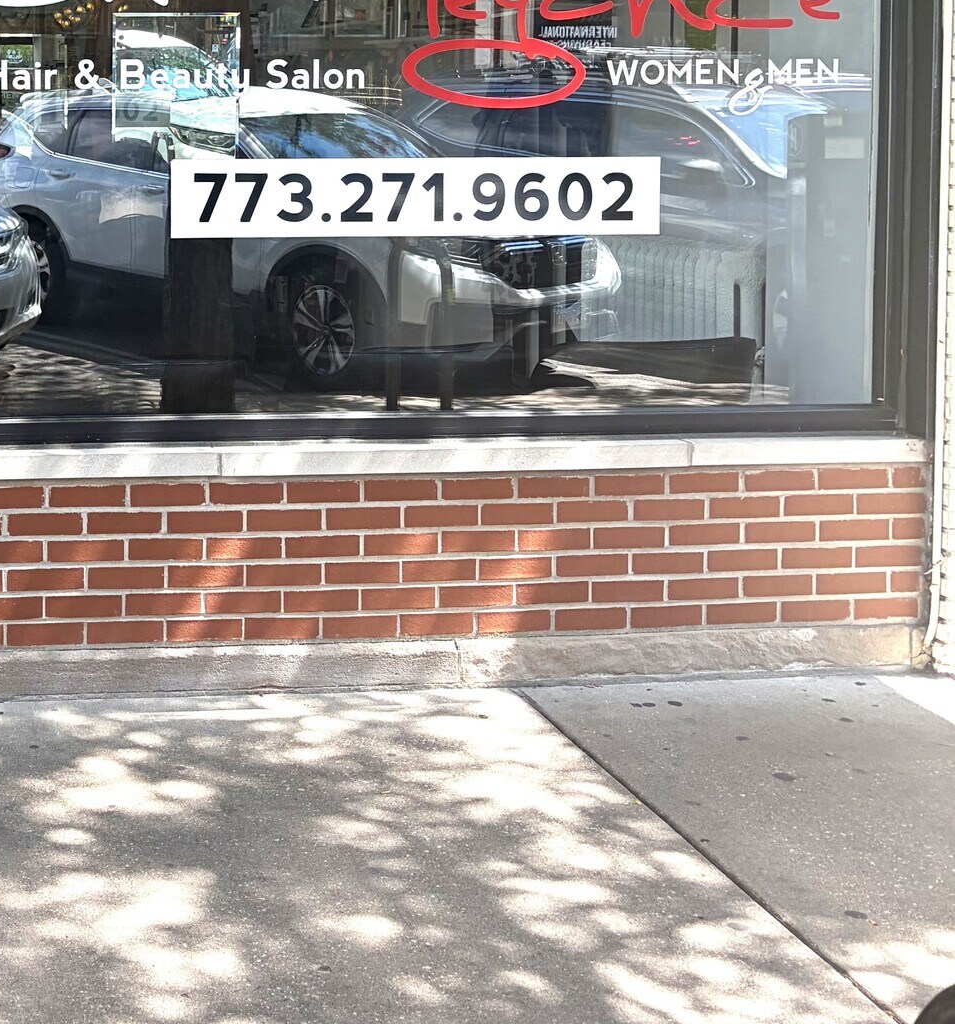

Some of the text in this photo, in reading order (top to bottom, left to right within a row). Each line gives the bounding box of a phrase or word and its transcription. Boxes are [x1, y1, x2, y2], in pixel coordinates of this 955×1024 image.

[74, 59, 100, 90] &
[120, 59, 250, 98] Beauty
[266, 59, 366, 90] Salon
[605, 59, 741, 86] WOMEN
[767, 58, 840, 85] MEN
[193, 172, 635, 223] 773.271.9602
